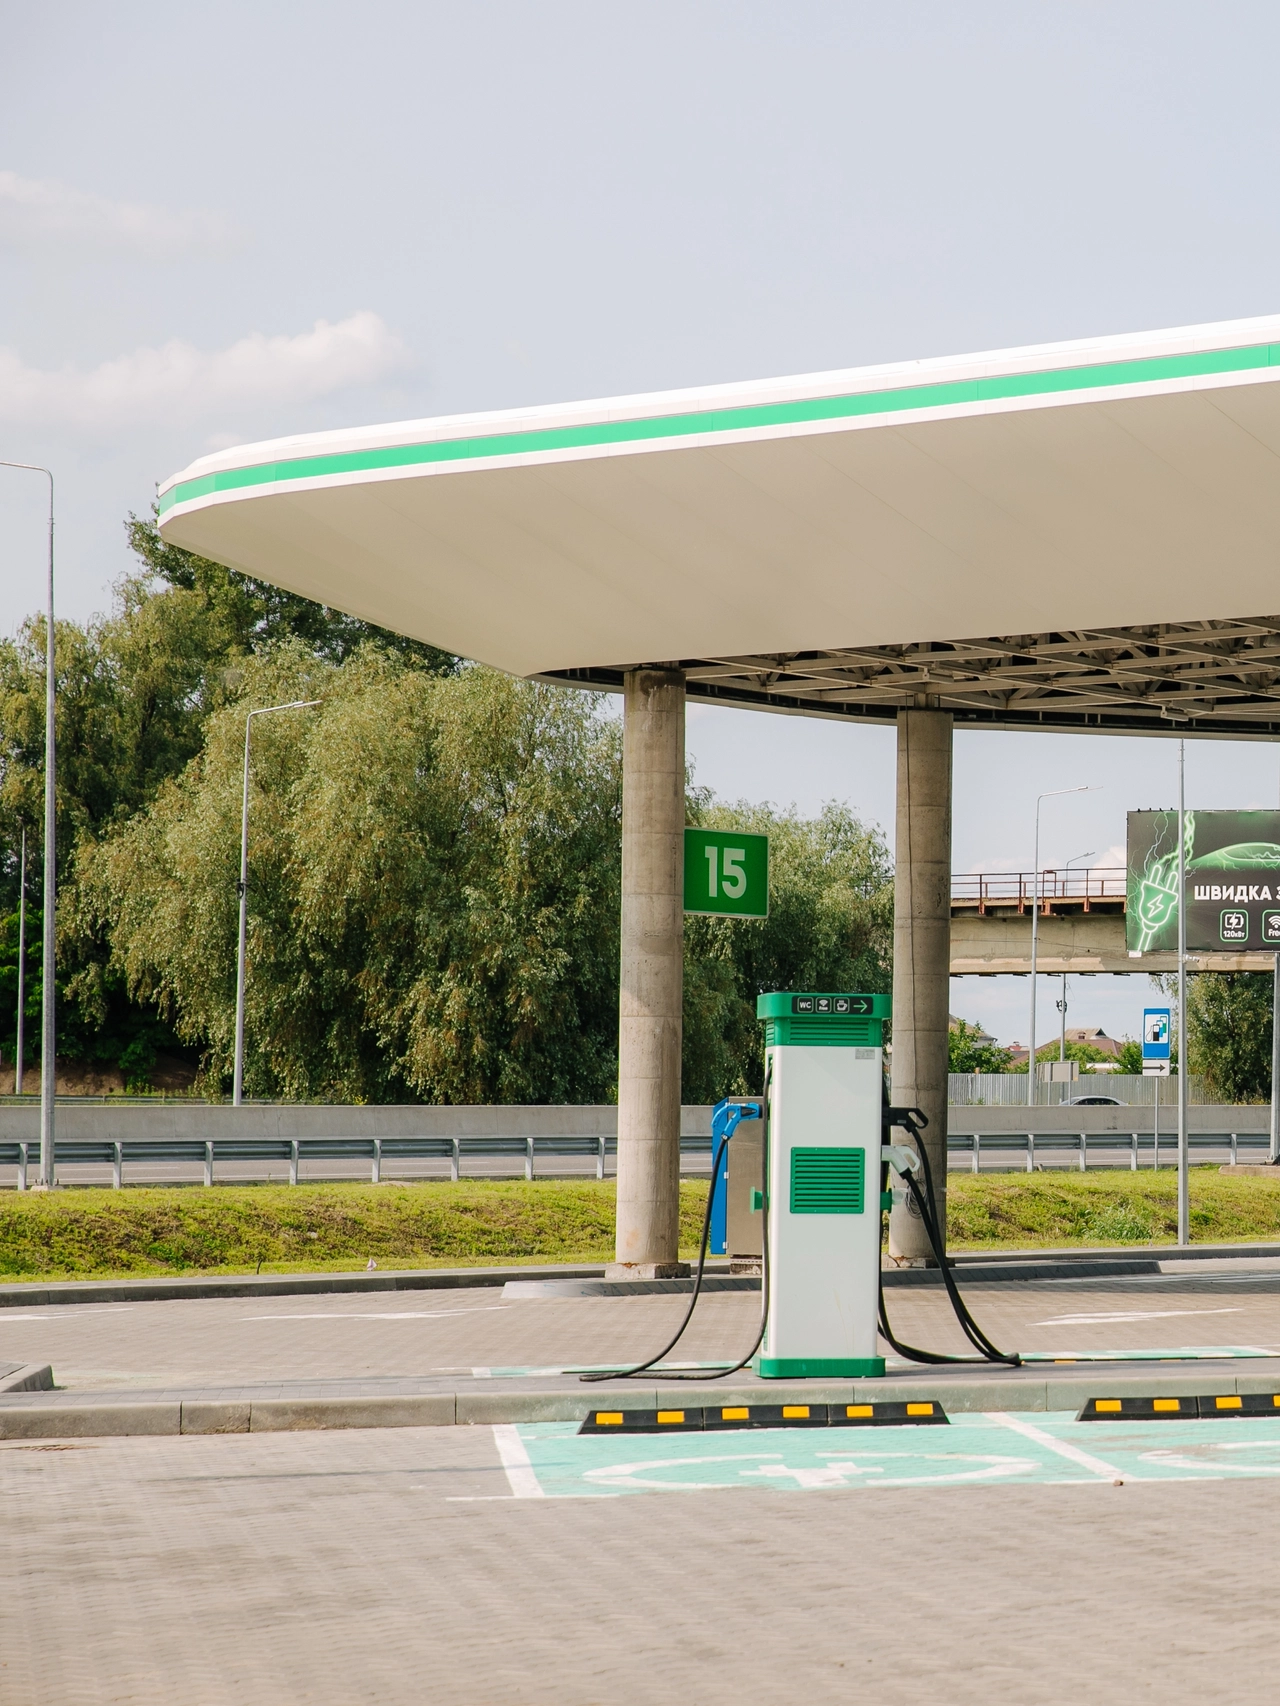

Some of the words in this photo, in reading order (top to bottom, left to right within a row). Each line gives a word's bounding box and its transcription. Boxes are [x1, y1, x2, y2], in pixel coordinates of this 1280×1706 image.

[705, 845, 747, 899] 15
[1194, 885, 1272, 903] ШВИДКА
[799, 1001, 812, 1009] WC
